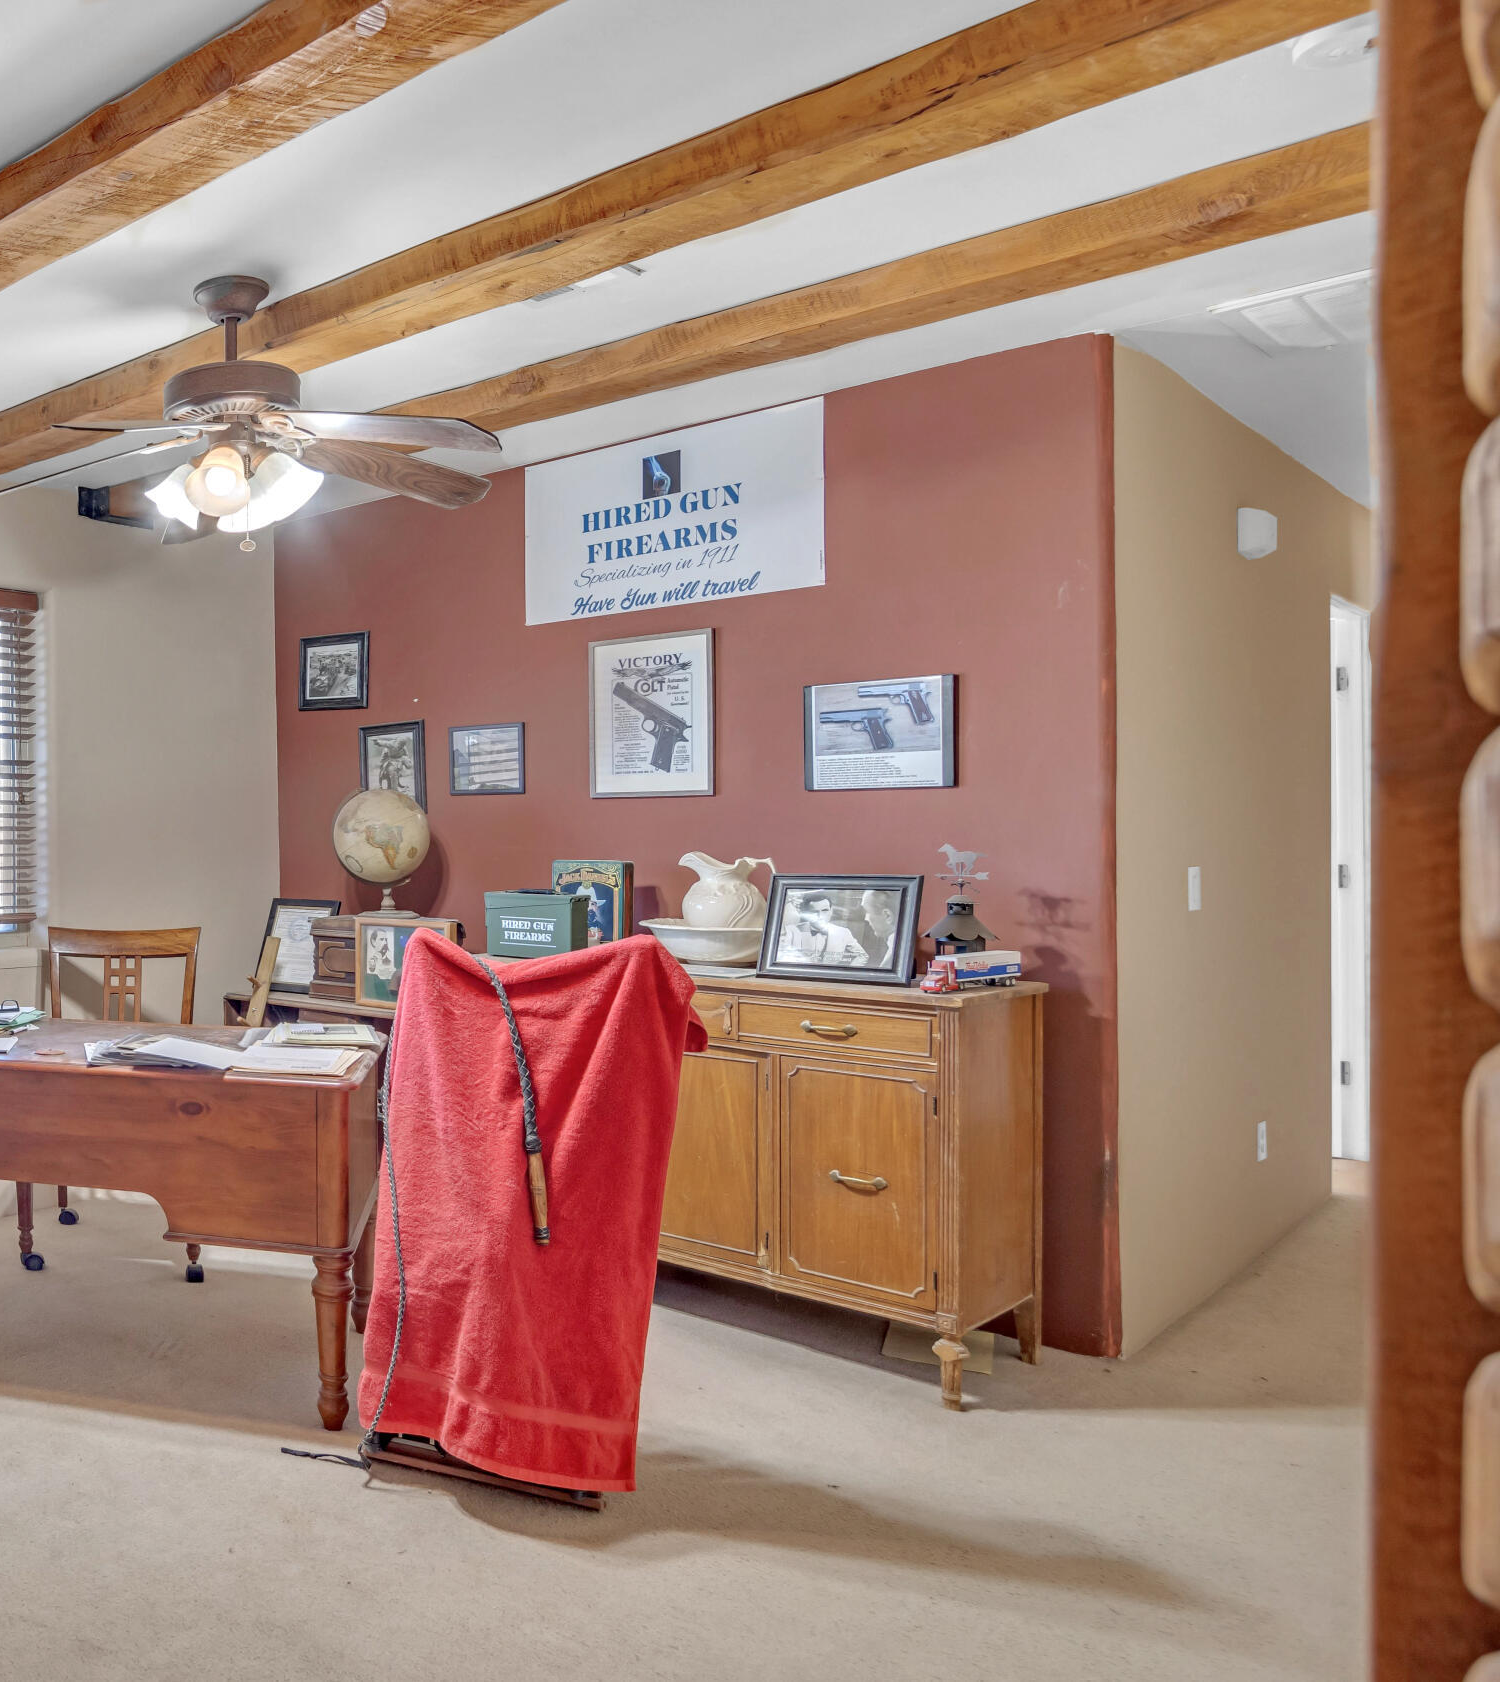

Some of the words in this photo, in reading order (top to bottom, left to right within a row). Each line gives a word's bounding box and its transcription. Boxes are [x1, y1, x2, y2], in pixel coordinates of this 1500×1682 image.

[582, 498, 672, 533] HIRED
[679, 482, 742, 514] GUN
[587, 518, 738, 564] FIREARMS
[574, 560, 673, 589] Specializing
[675, 557, 693, 571] in
[696, 543, 739, 569] 1911
[570, 594, 615, 616] Have
[620, 588, 659, 610] Gun
[662, 580, 700, 603] will
[701, 571, 761, 598] travel
[618, 653, 683, 669] VICTORY
[634, 677, 666, 696] COLT
[502, 919, 531, 930] HIRED
[533, 921, 554, 931] GUN
[504, 931, 552, 942] FIREARMS
